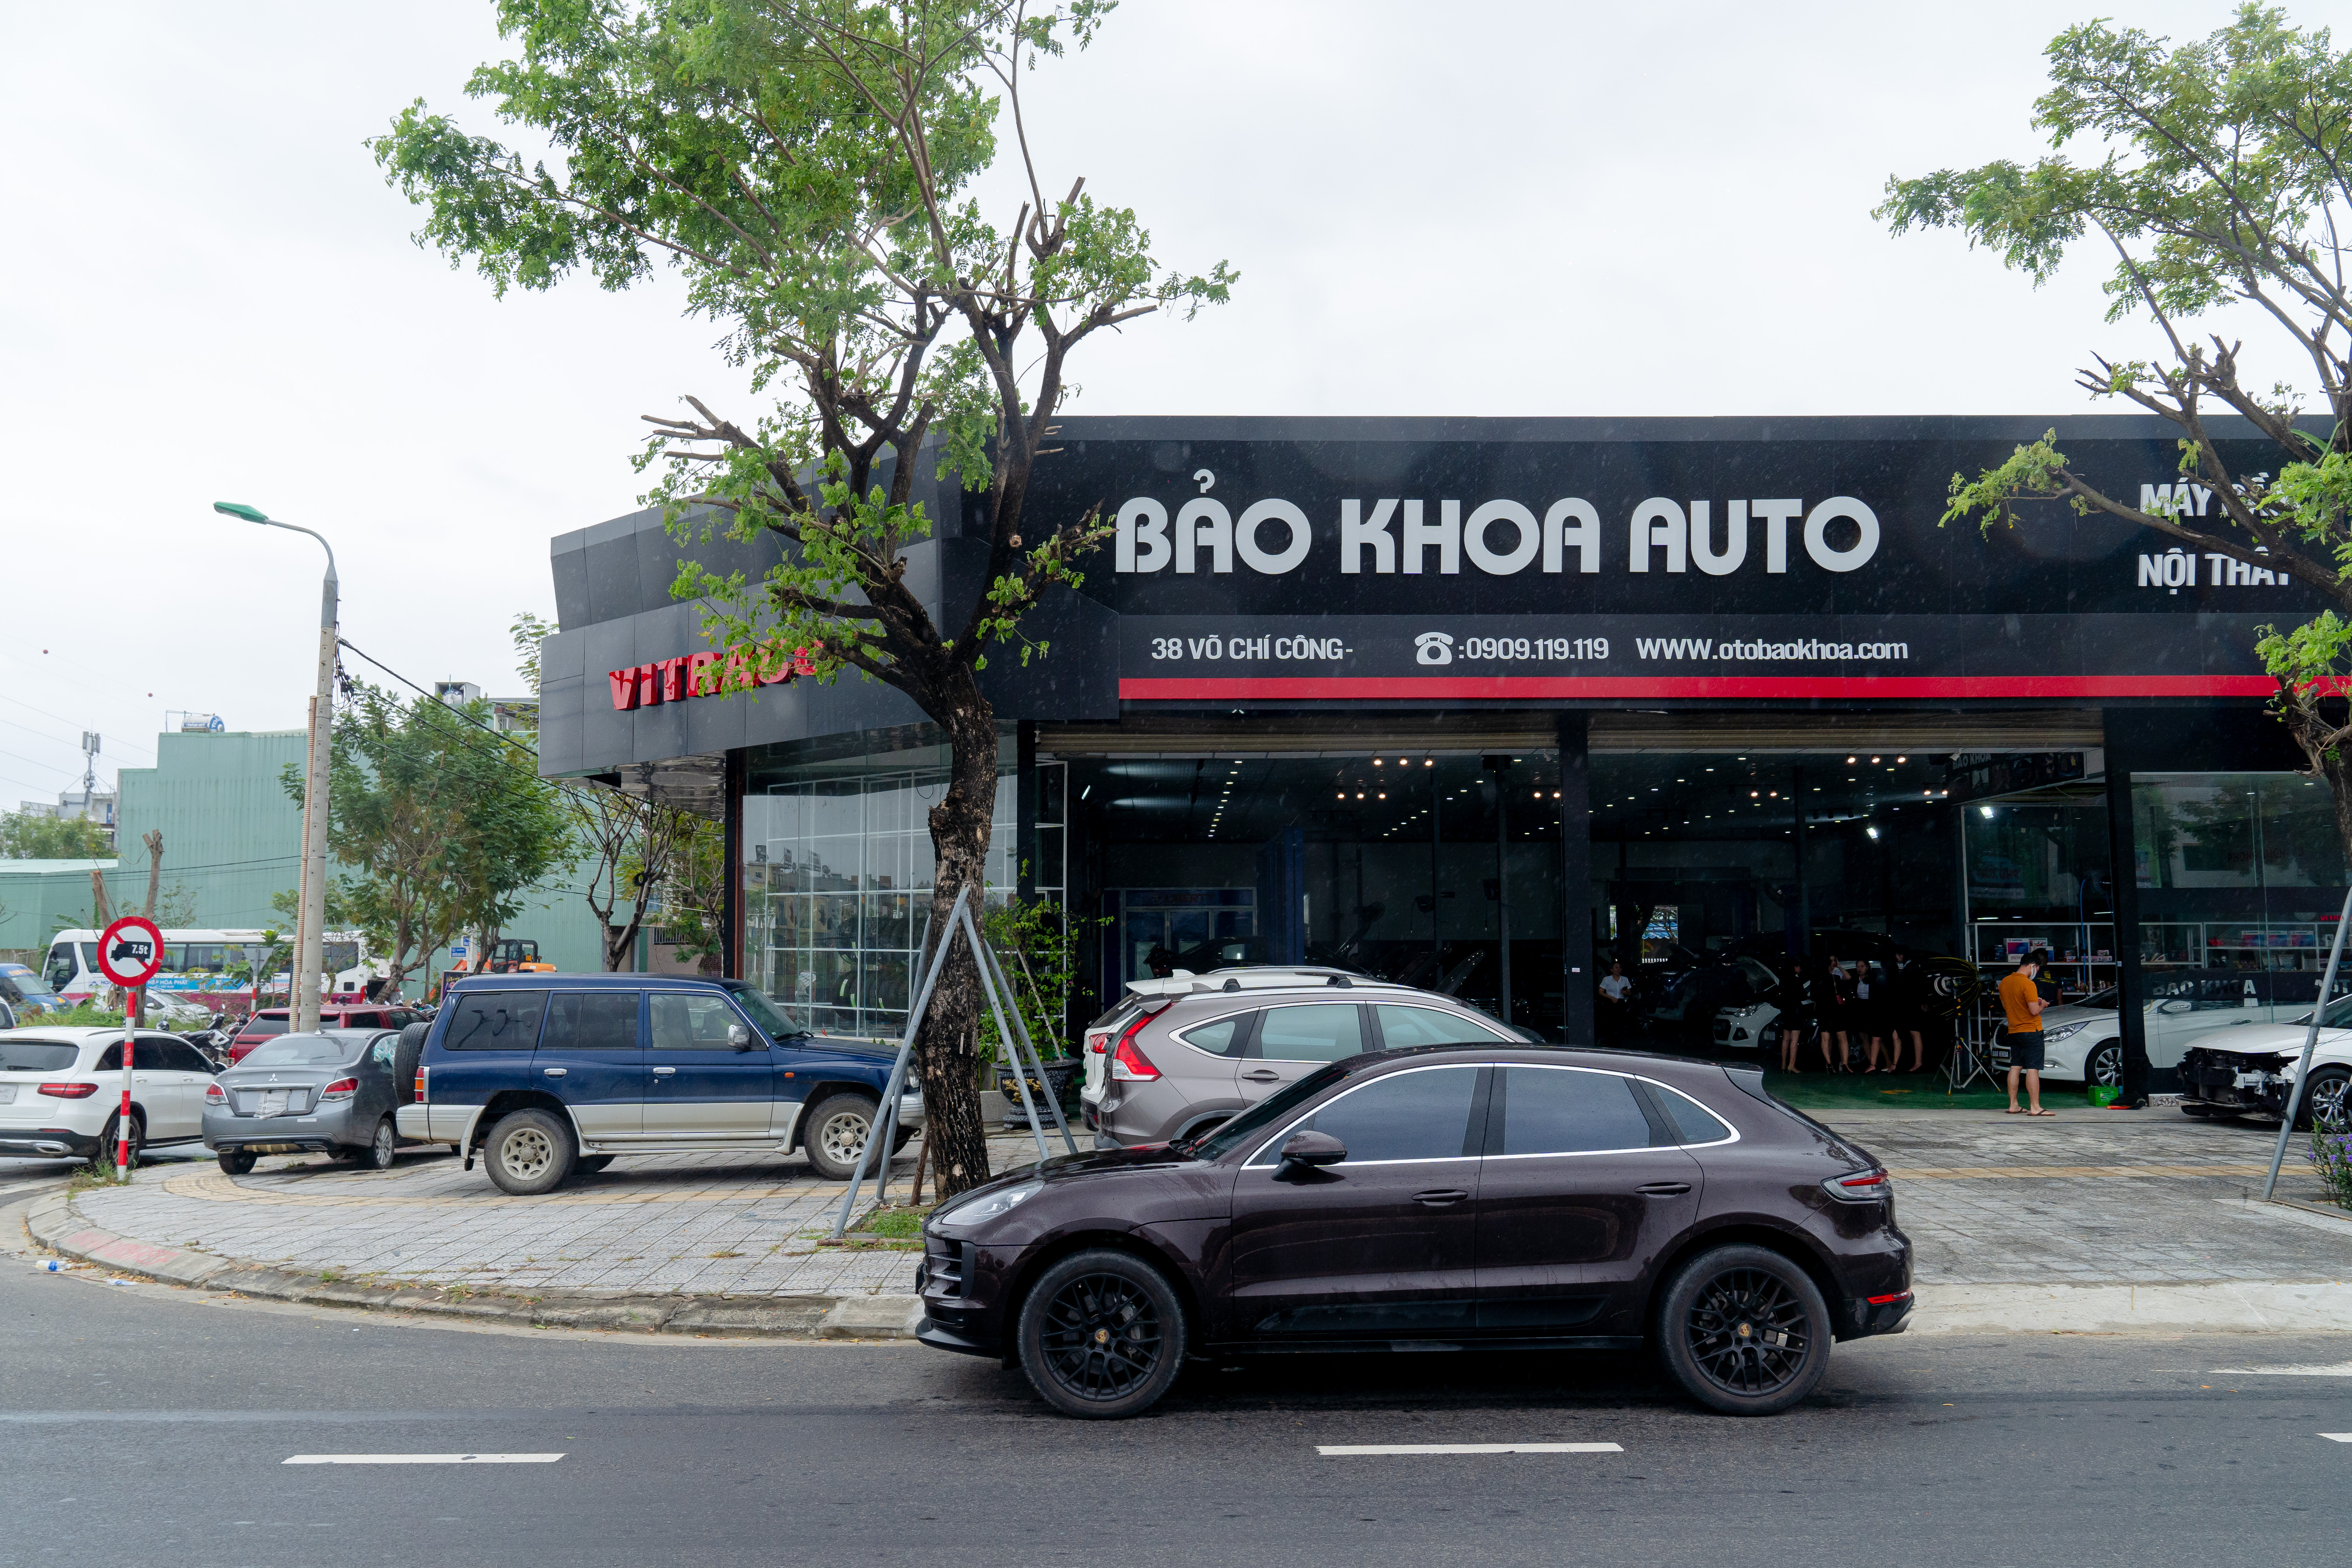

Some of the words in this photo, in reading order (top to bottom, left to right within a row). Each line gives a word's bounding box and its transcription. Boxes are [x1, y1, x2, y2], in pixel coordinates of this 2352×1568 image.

[2140, 477, 2211, 516] MÁY
[1116, 469, 1311, 574] BẢO
[1341, 498, 1600, 575] KHOA
[1630, 497, 1879, 575] AUTO
[2139, 548, 2195, 594] NỘI
[1152, 638, 1182, 659] 38
[1188, 635, 1222, 659] VÕ
[1229, 635, 1270, 659] CHÍ
[132, 944, 148, 955] 7.5t
